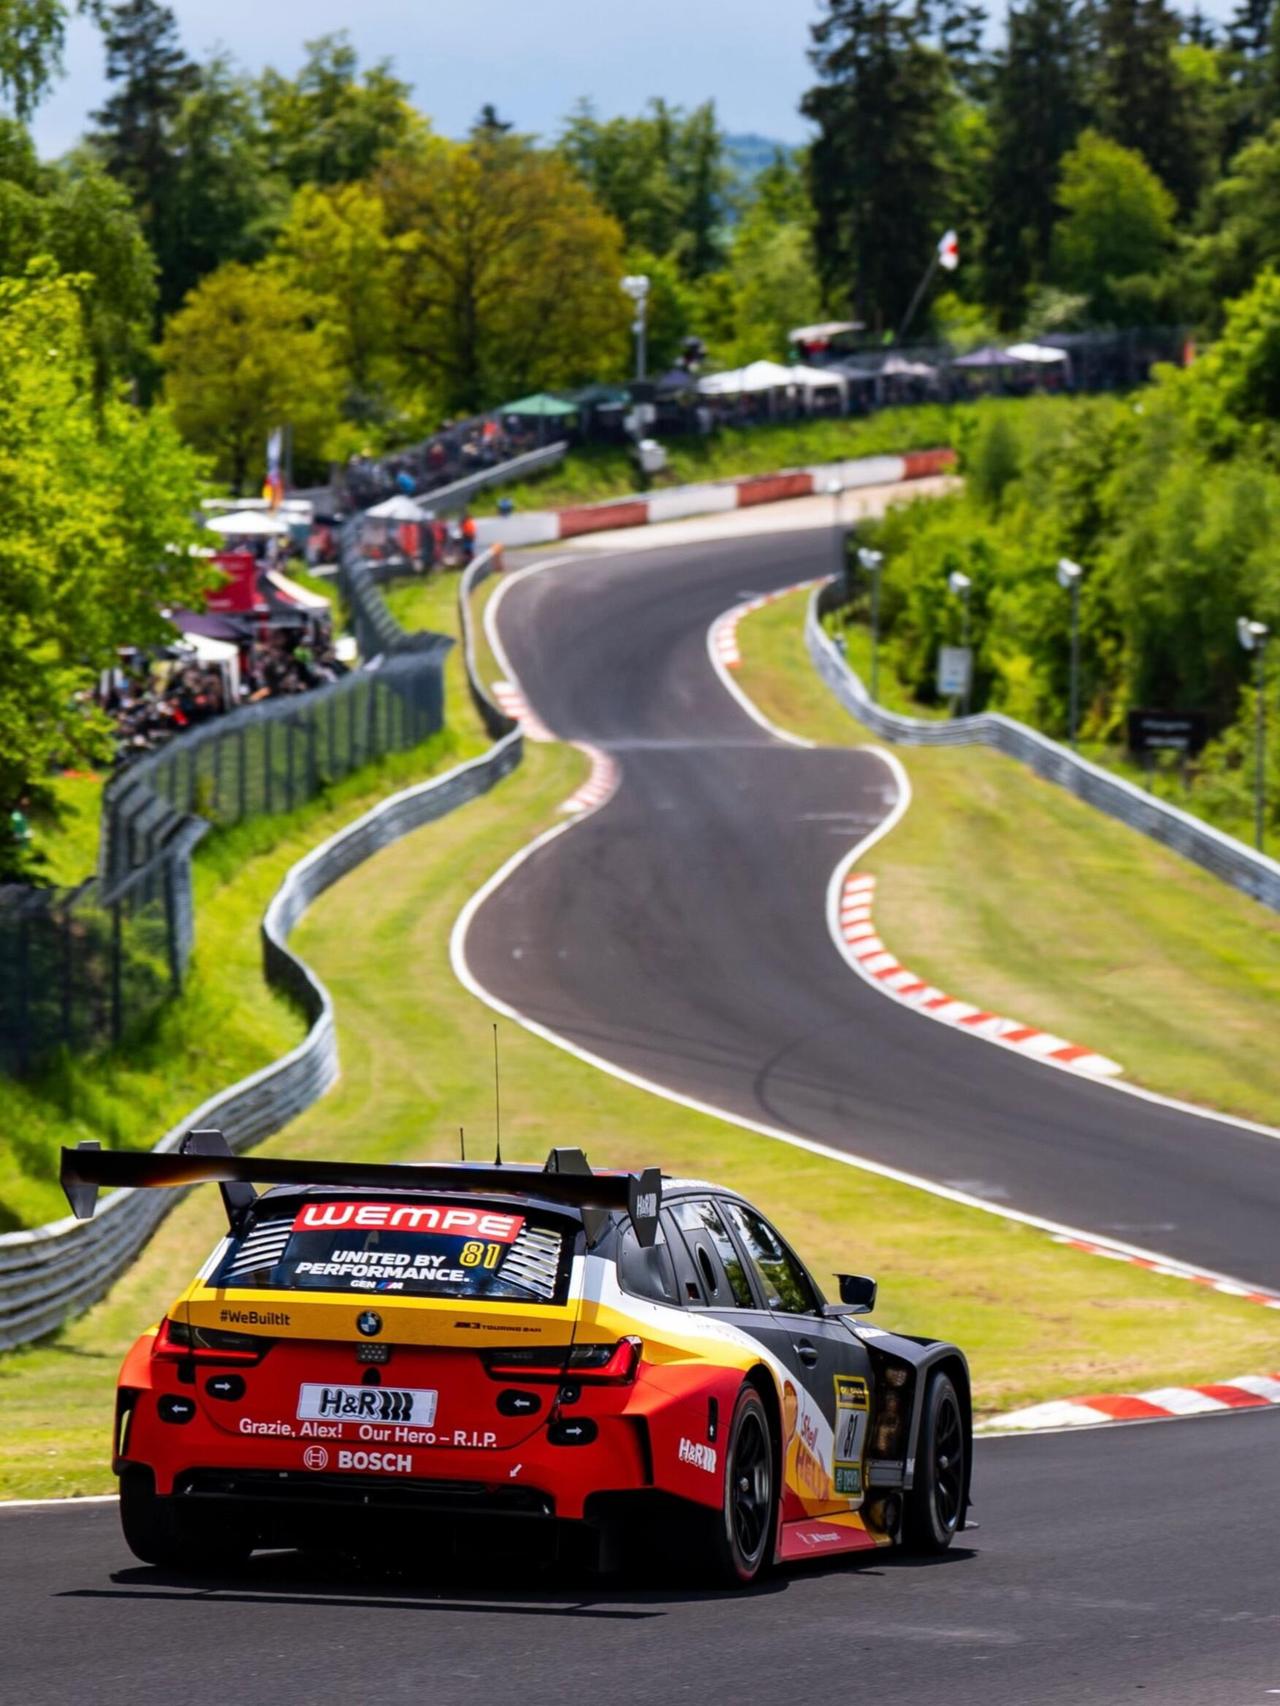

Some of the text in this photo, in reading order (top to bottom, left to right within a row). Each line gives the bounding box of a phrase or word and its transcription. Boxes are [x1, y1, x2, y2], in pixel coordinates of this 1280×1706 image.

[304, 1205, 515, 1237] WEMPE
[331, 1250, 447, 1267] UNITED BY
[458, 1240, 501, 1269] 81
[295, 1262, 471, 1282] PERFORMANCE.
[350, 1281, 377, 1289] GEN
[220, 1309, 291, 1326] #WeBuiltIt
[319, 1388, 382, 1418] H&R
[239, 1418, 296, 1438] Grazie,
[300, 1422, 343, 1438] Alex!
[359, 1425, 391, 1442] Our
[395, 1427, 436, 1444] Hero
[454, 1430, 497, 1448] R.I.P.
[843, 1413, 859, 1458] 81
[338, 1450, 413, 1473] BOSCH
[679, 1437, 706, 1469] H&R
